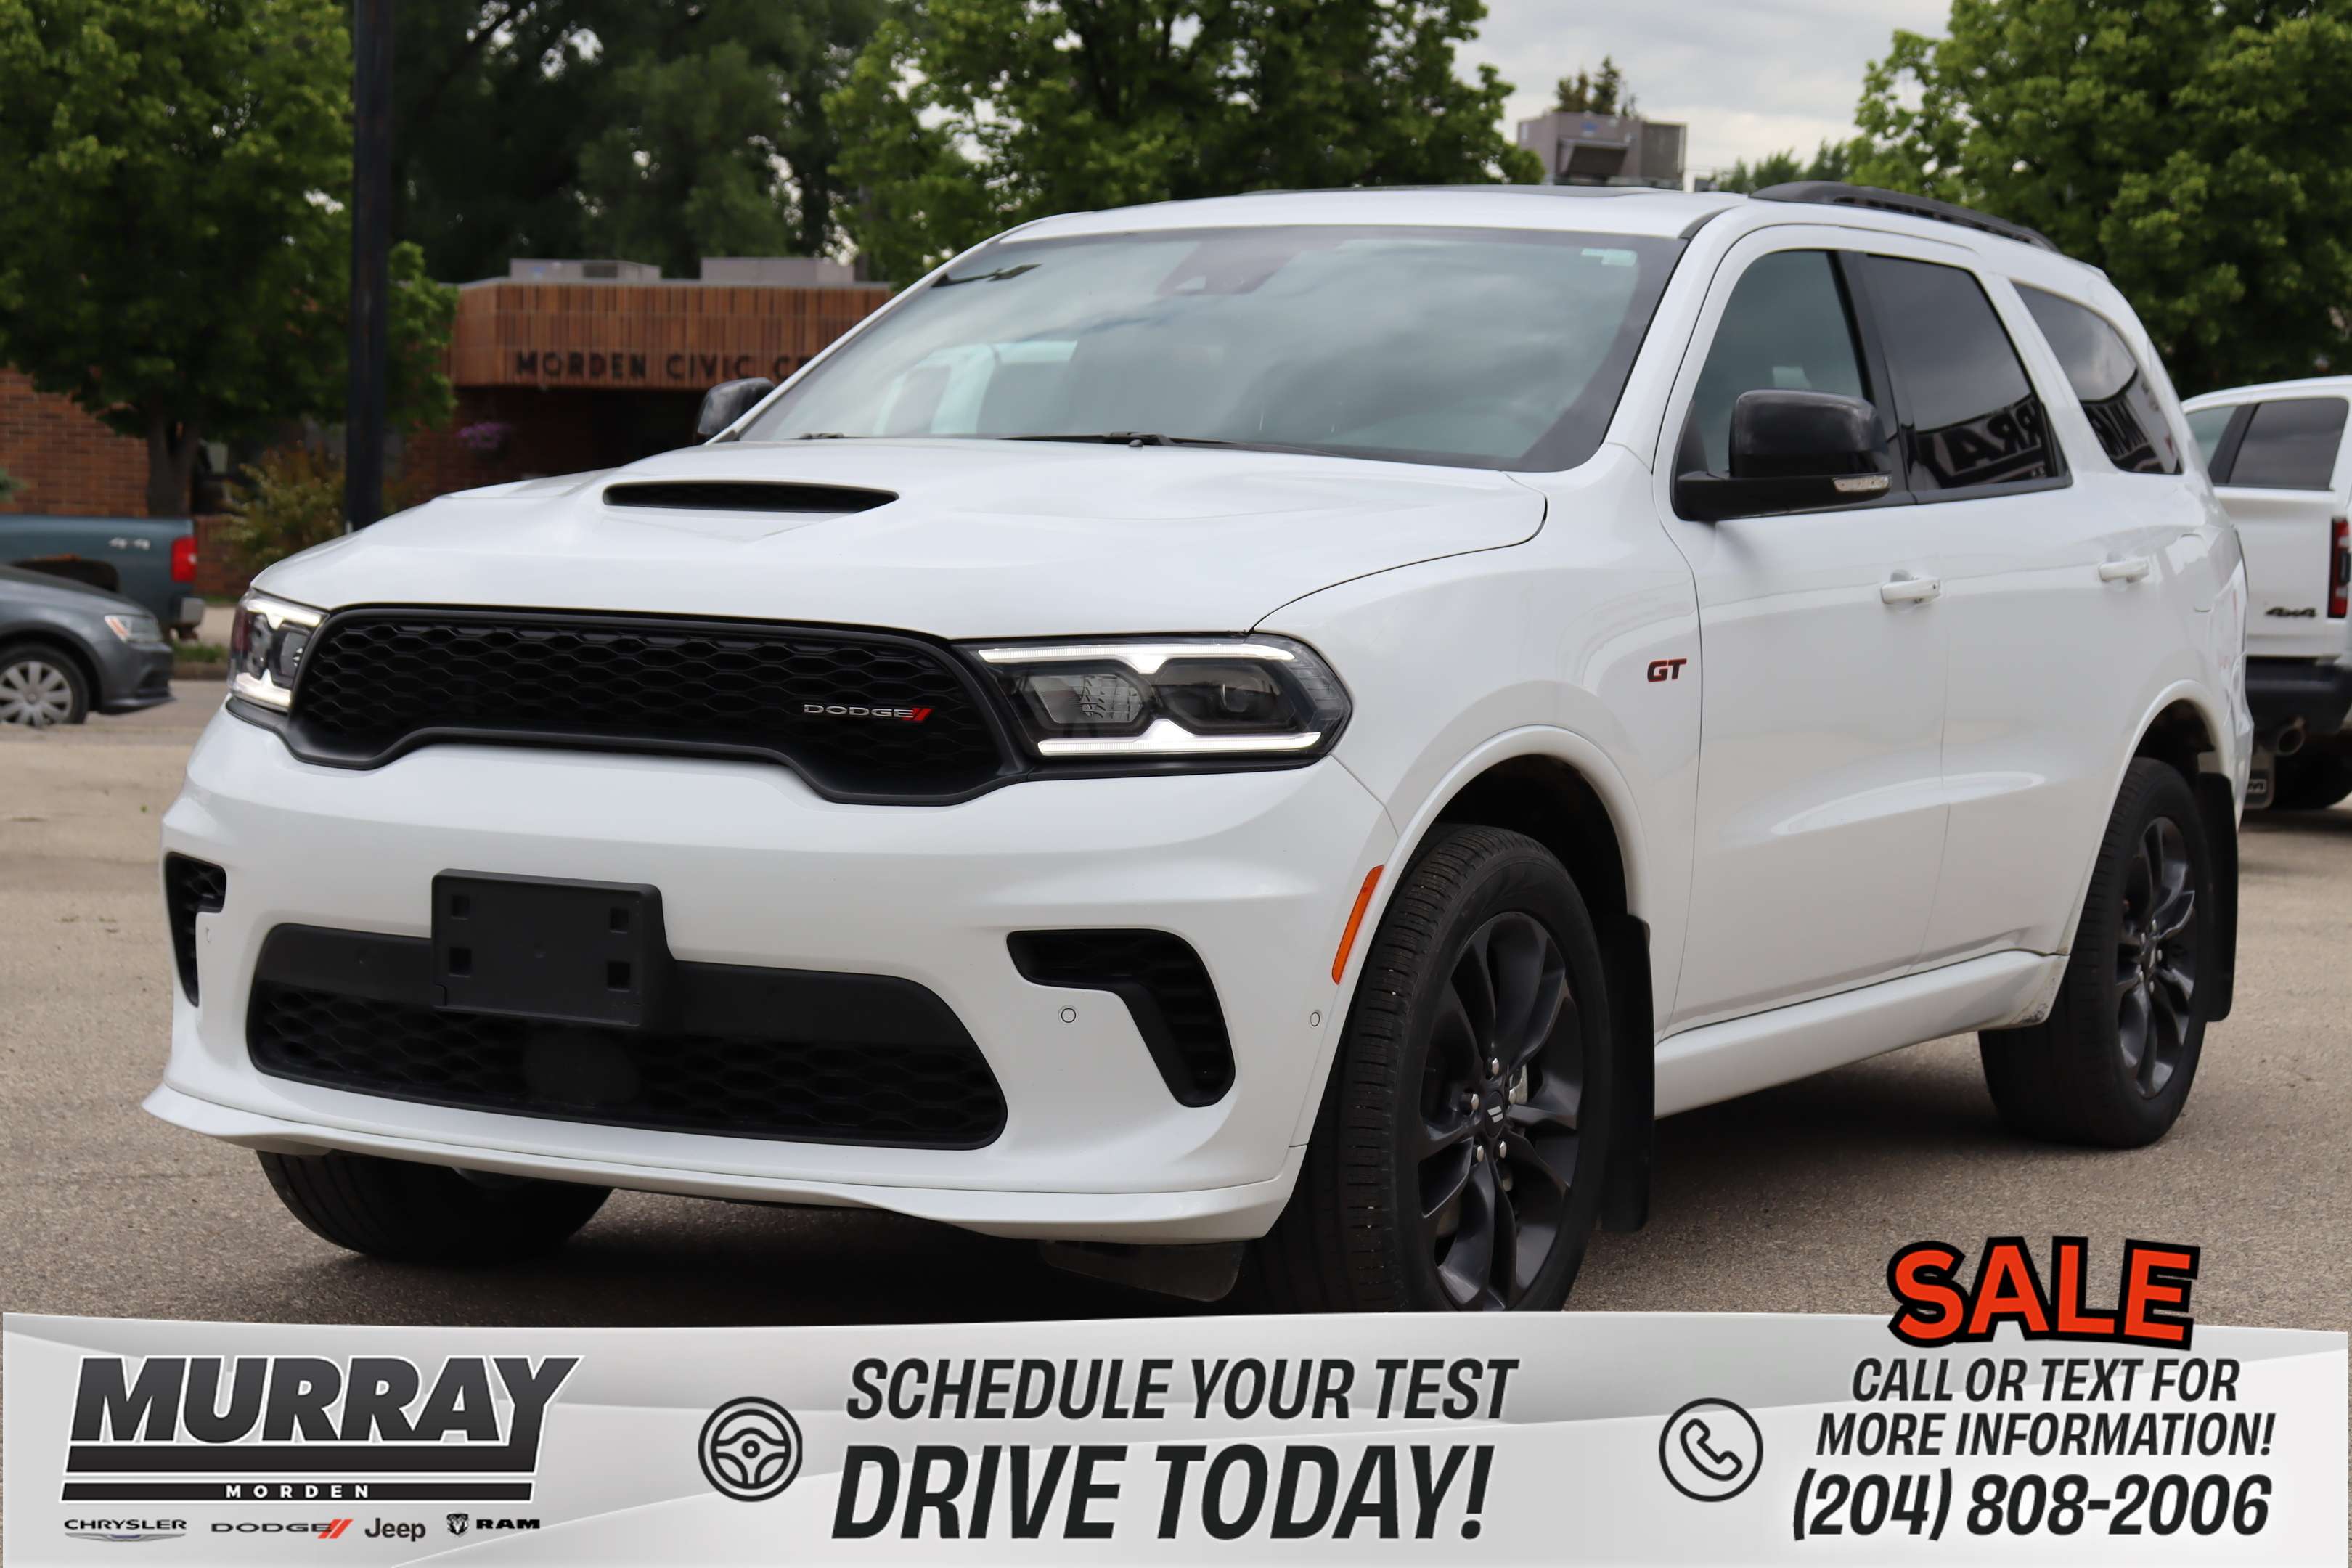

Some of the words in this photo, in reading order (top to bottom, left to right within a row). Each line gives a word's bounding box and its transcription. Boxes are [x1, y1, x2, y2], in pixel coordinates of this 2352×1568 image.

[515, 351, 647, 378] MORDEN
[666, 353, 755, 379] CIVIC
[1647, 658, 1687, 682] GT
[804, 704, 914, 718] DODGE
